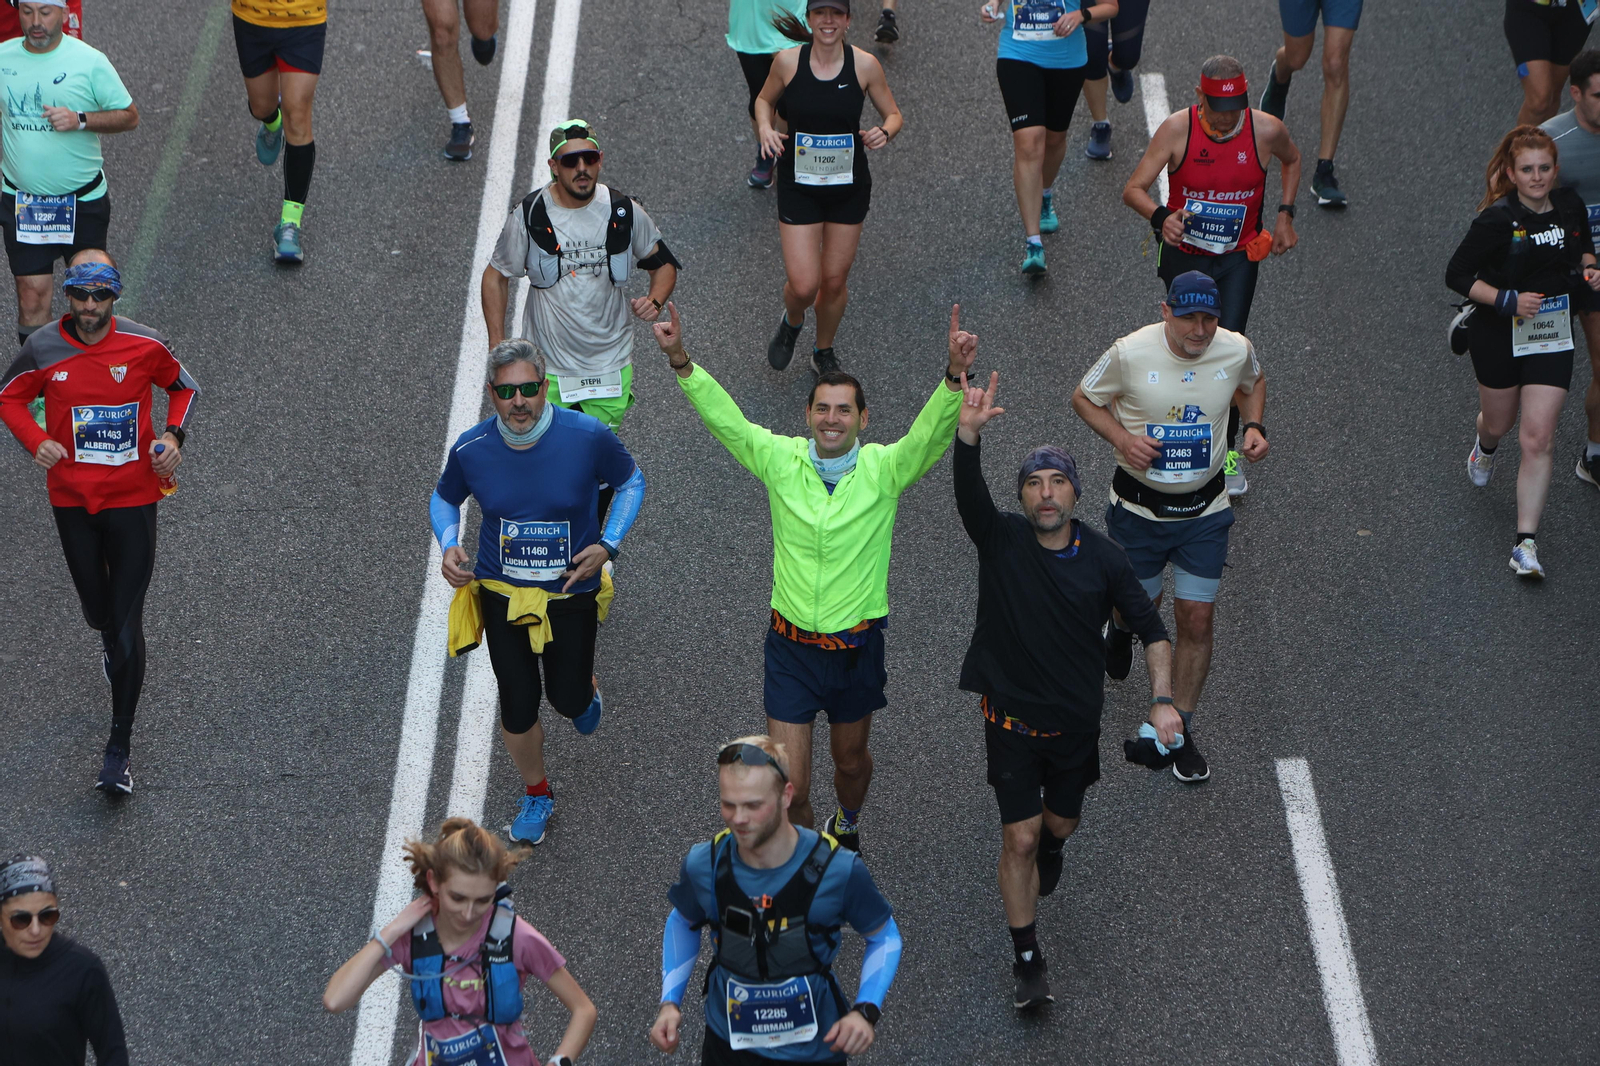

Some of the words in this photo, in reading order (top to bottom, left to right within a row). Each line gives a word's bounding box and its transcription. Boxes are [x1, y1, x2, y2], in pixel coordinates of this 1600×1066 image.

[1029, 13, 1050, 21] 11985
[11, 122, 55, 132] SEVILLA'2
[814, 156, 836, 164] 11202
[1182, 186, 1205, 199] Los
[1207, 188, 1256, 200] Lentos
[1206, 206, 1238, 216] ZURICH
[34, 213, 57, 222] 12287
[19, 224, 41, 232] BRUNO
[42, 224, 71, 232] MARTINS
[1201, 222, 1225, 232] 11512
[1190, 229, 1204, 239] DON
[1204, 233, 1233, 243] ANTONIO
[565, 240, 589, 248] NIKE
[1180, 293, 1215, 306] UTMB
[1539, 300, 1563, 311] URICH
[1532, 320, 1555, 330] 10642
[580, 378, 601, 387] STEPH
[98, 409, 132, 419] ZURICH
[97, 430, 122, 439] 11463
[1169, 428, 1203, 437] ZURICH
[84, 441, 116, 451] ALBERTO
[1165, 448, 1192, 457] 12463
[1165, 461, 1191, 469] KLITON
[1167, 501, 1206, 512] SALOMON
[523, 527, 560, 535] ZURICH
[521, 546, 548, 555] 11460
[505, 557, 528, 567] LUCHA
[530, 559, 547, 567] VIVE
[549, 558, 566, 567] AMA
[754, 984, 798, 998] ZURICH
[754, 1008, 788, 1020] 12285
[752, 1021, 794, 1033] GERMAIN
